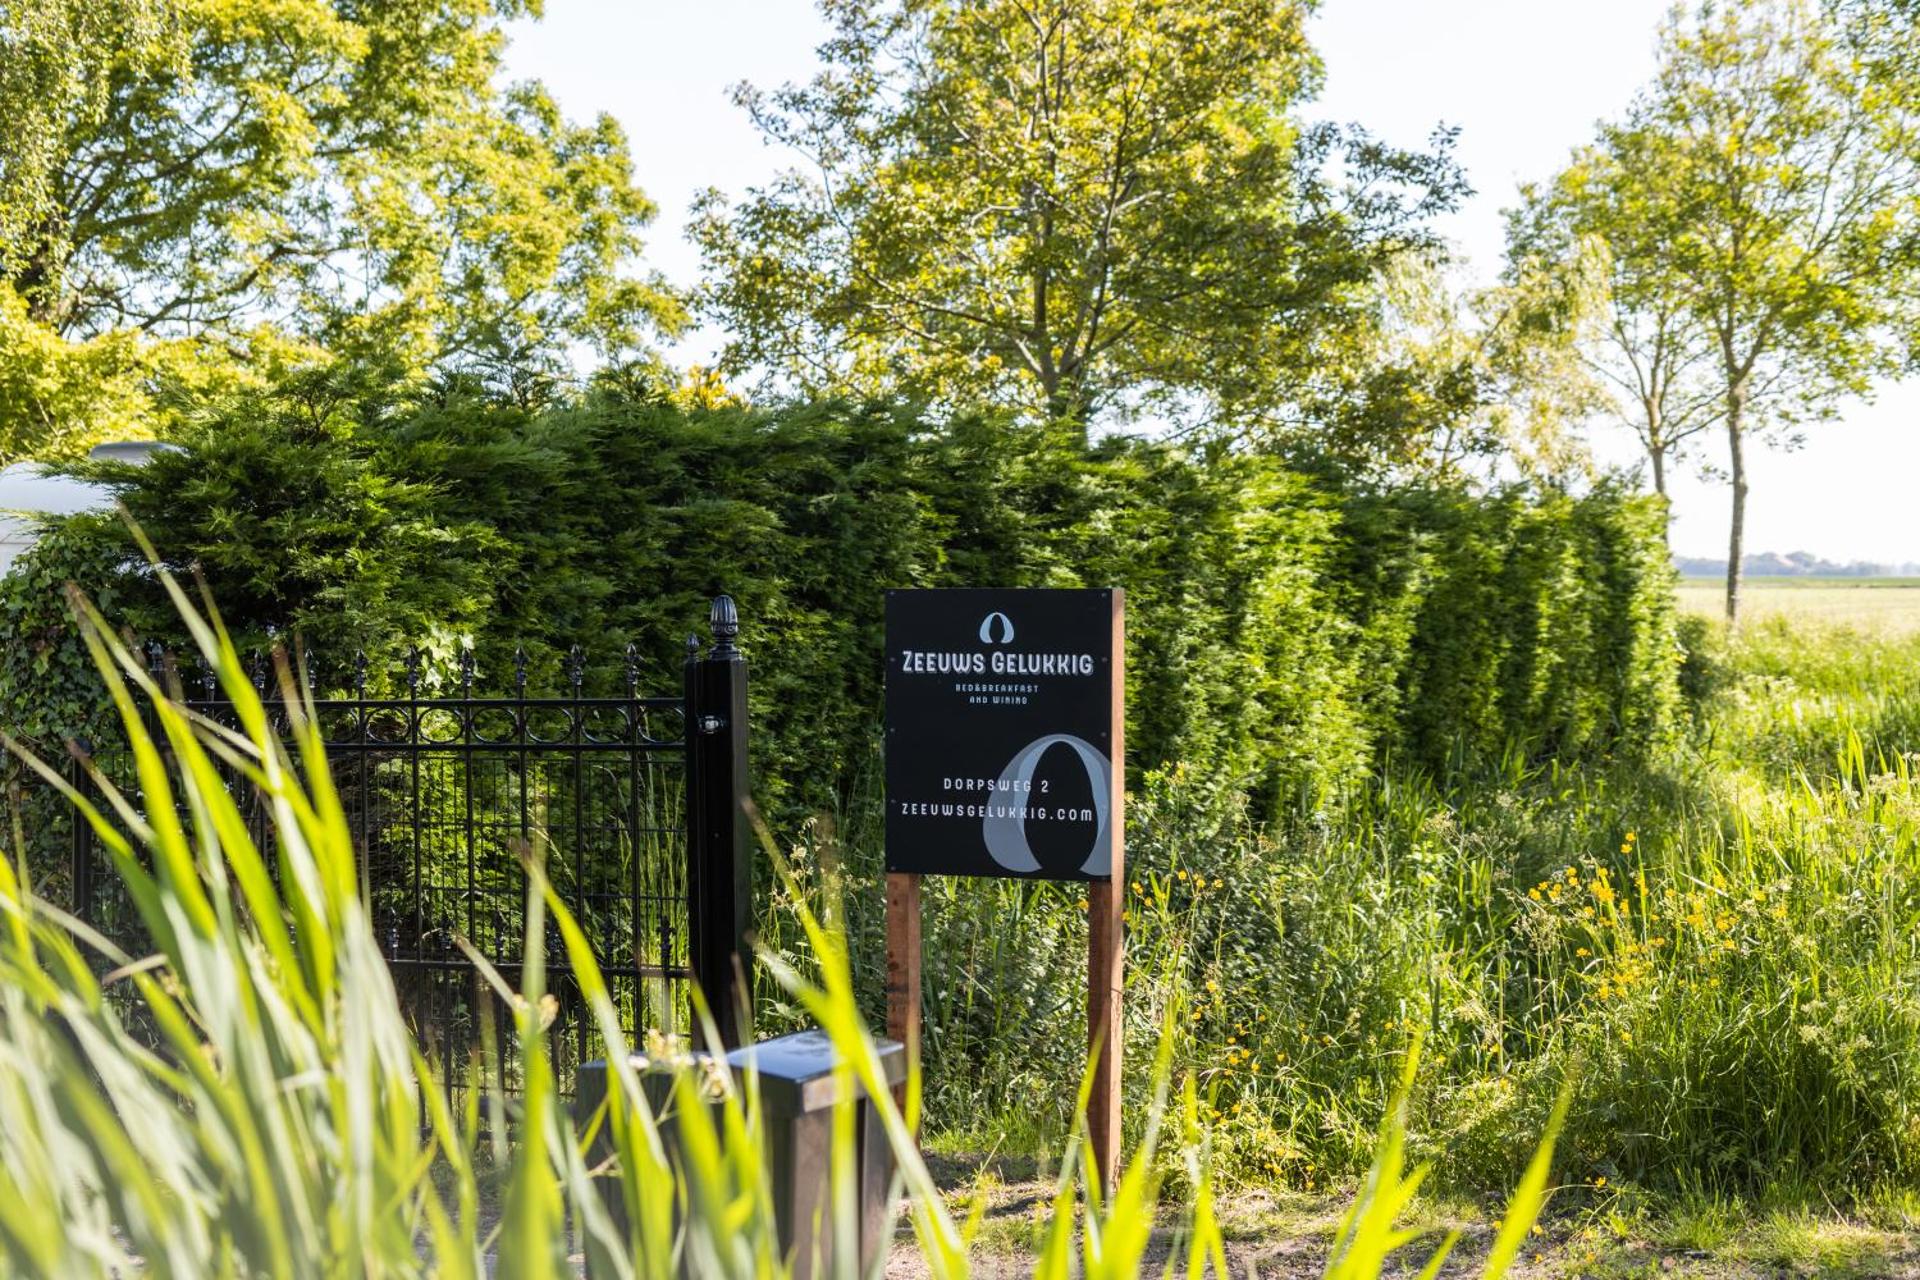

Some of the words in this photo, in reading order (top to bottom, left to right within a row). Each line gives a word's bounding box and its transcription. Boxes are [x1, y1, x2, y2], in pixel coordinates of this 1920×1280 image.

[903, 650, 985, 675] ZEEUWS
[991, 651, 1094, 676] GELUKKIG
[969, 696, 988, 704] AND
[944, 778, 1031, 792] DORPSWEG
[1041, 780, 1049, 793] 2
